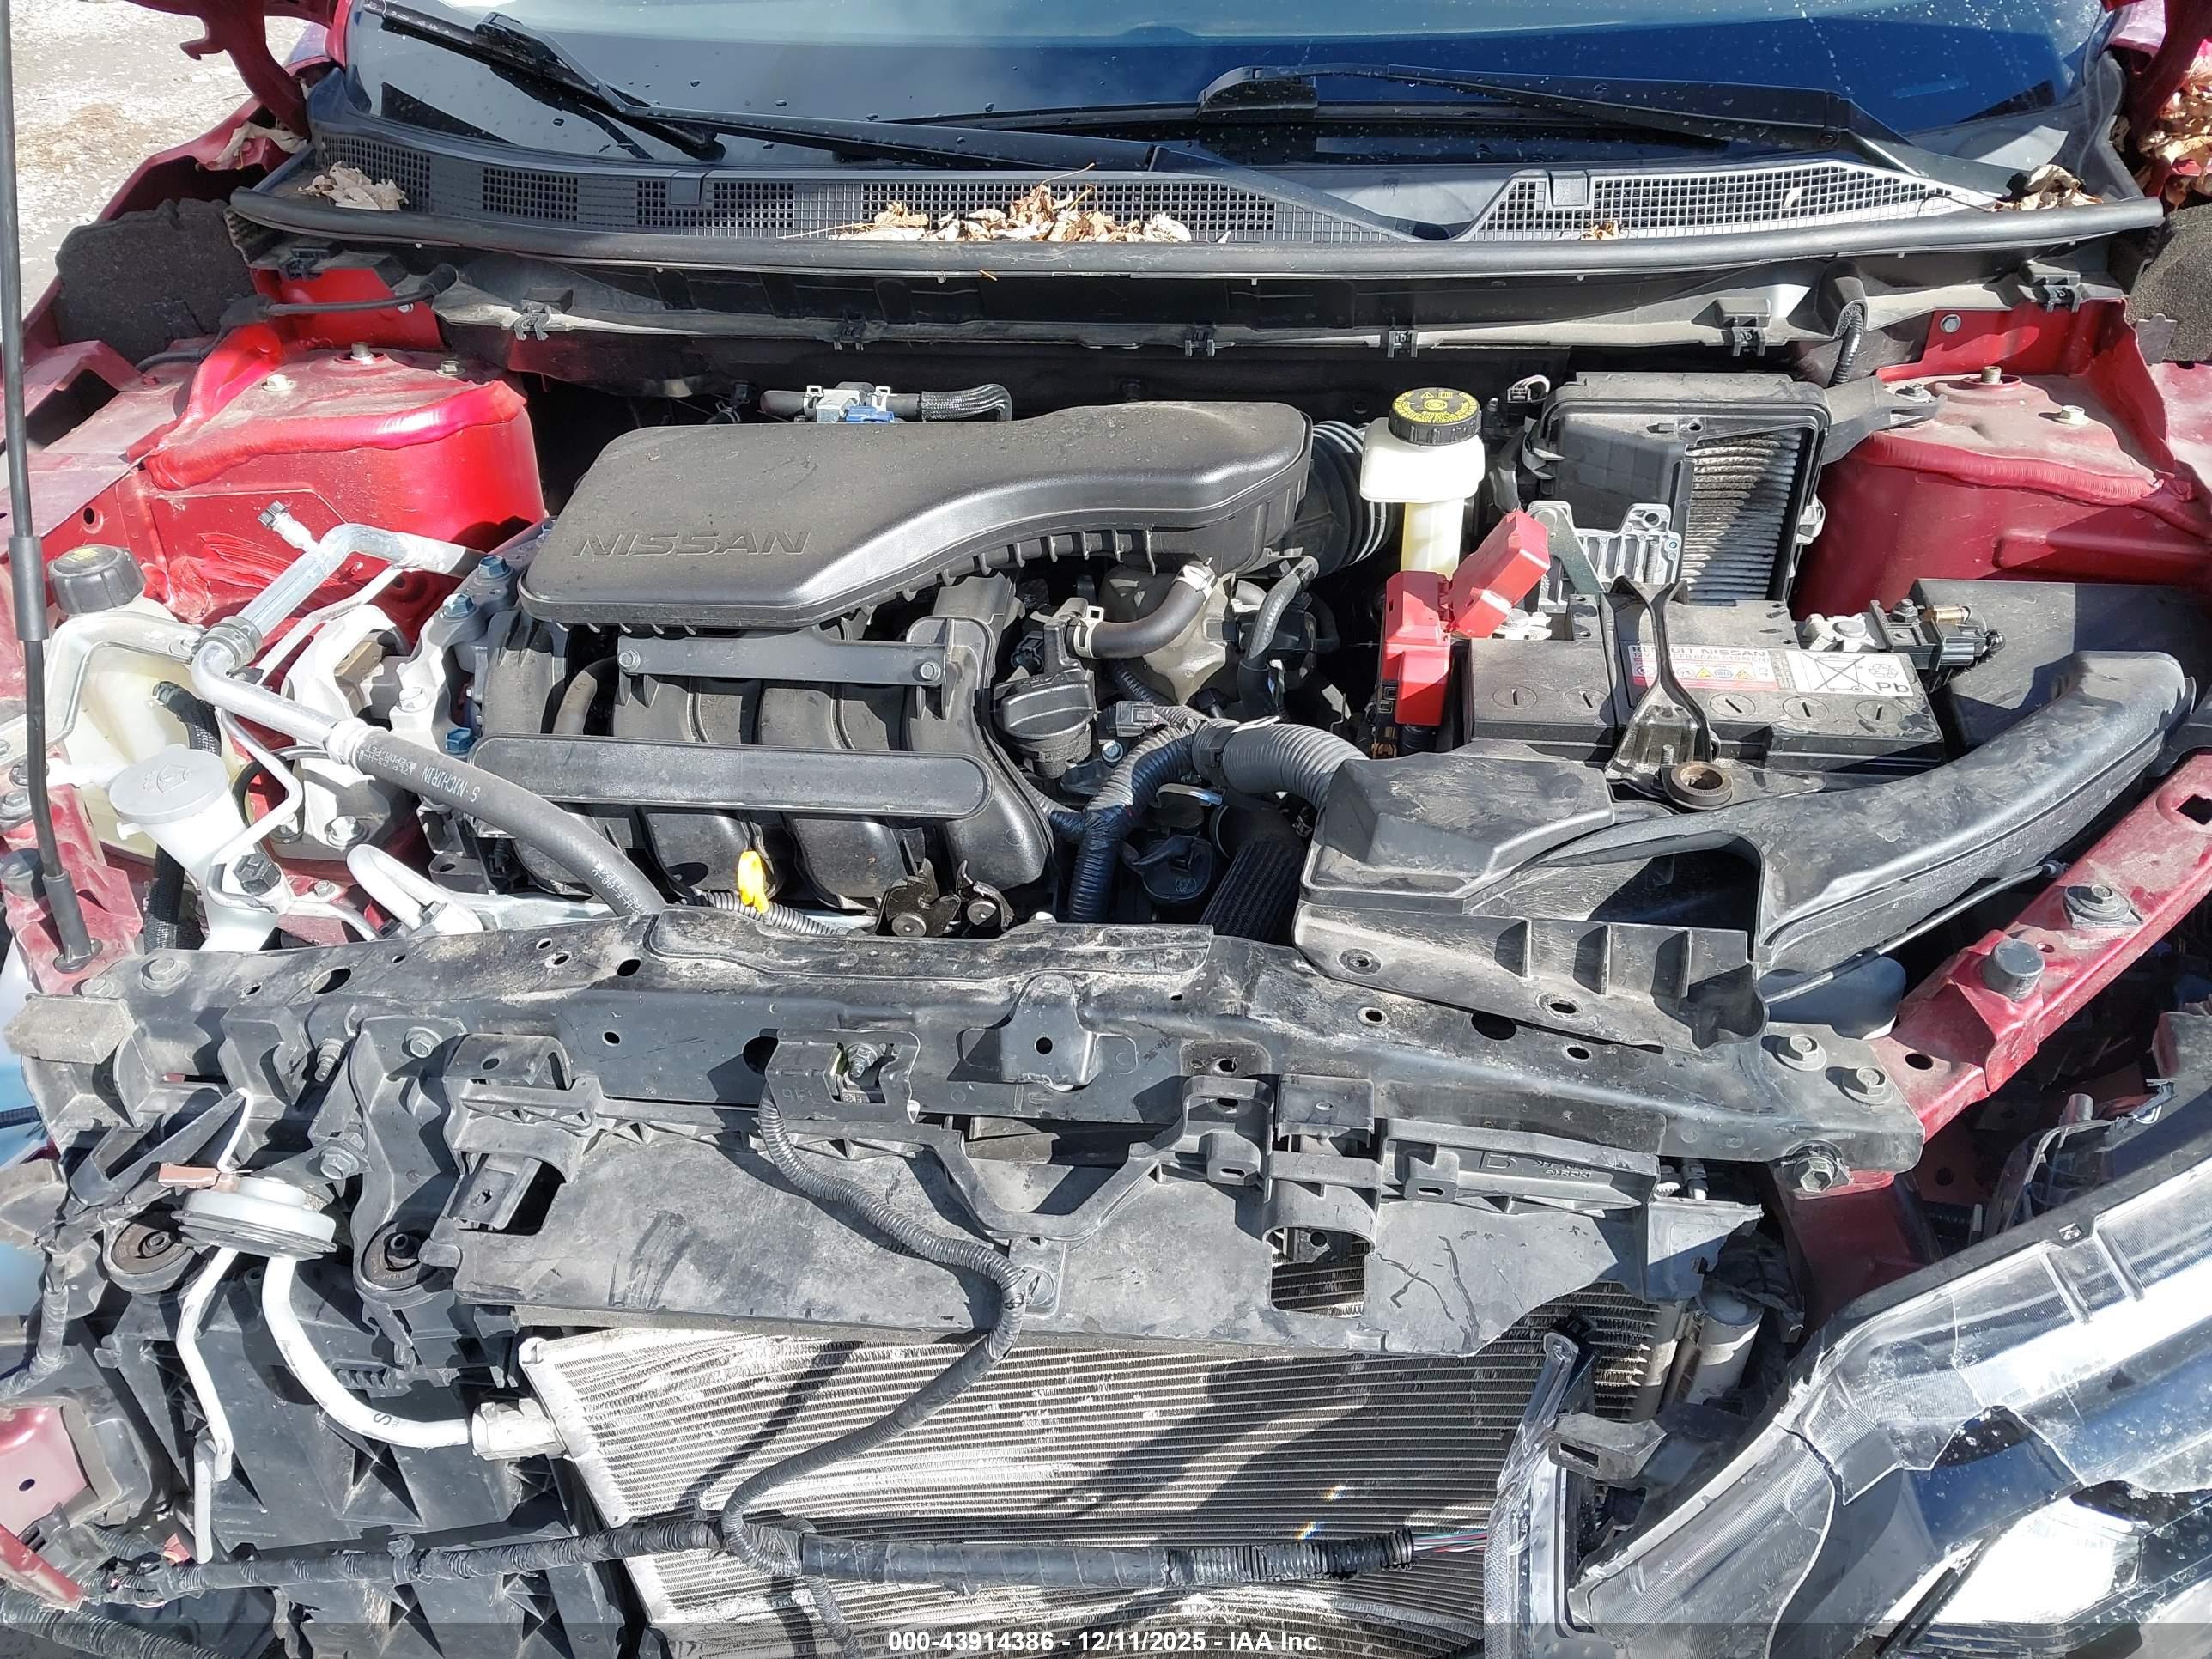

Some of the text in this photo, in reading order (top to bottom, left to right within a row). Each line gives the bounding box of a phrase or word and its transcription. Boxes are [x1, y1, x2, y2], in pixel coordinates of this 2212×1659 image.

[570, 532, 811, 557] NISSAN
[1701, 647, 1765, 657] NISSAN
[1876, 681, 1910, 693] Pb
